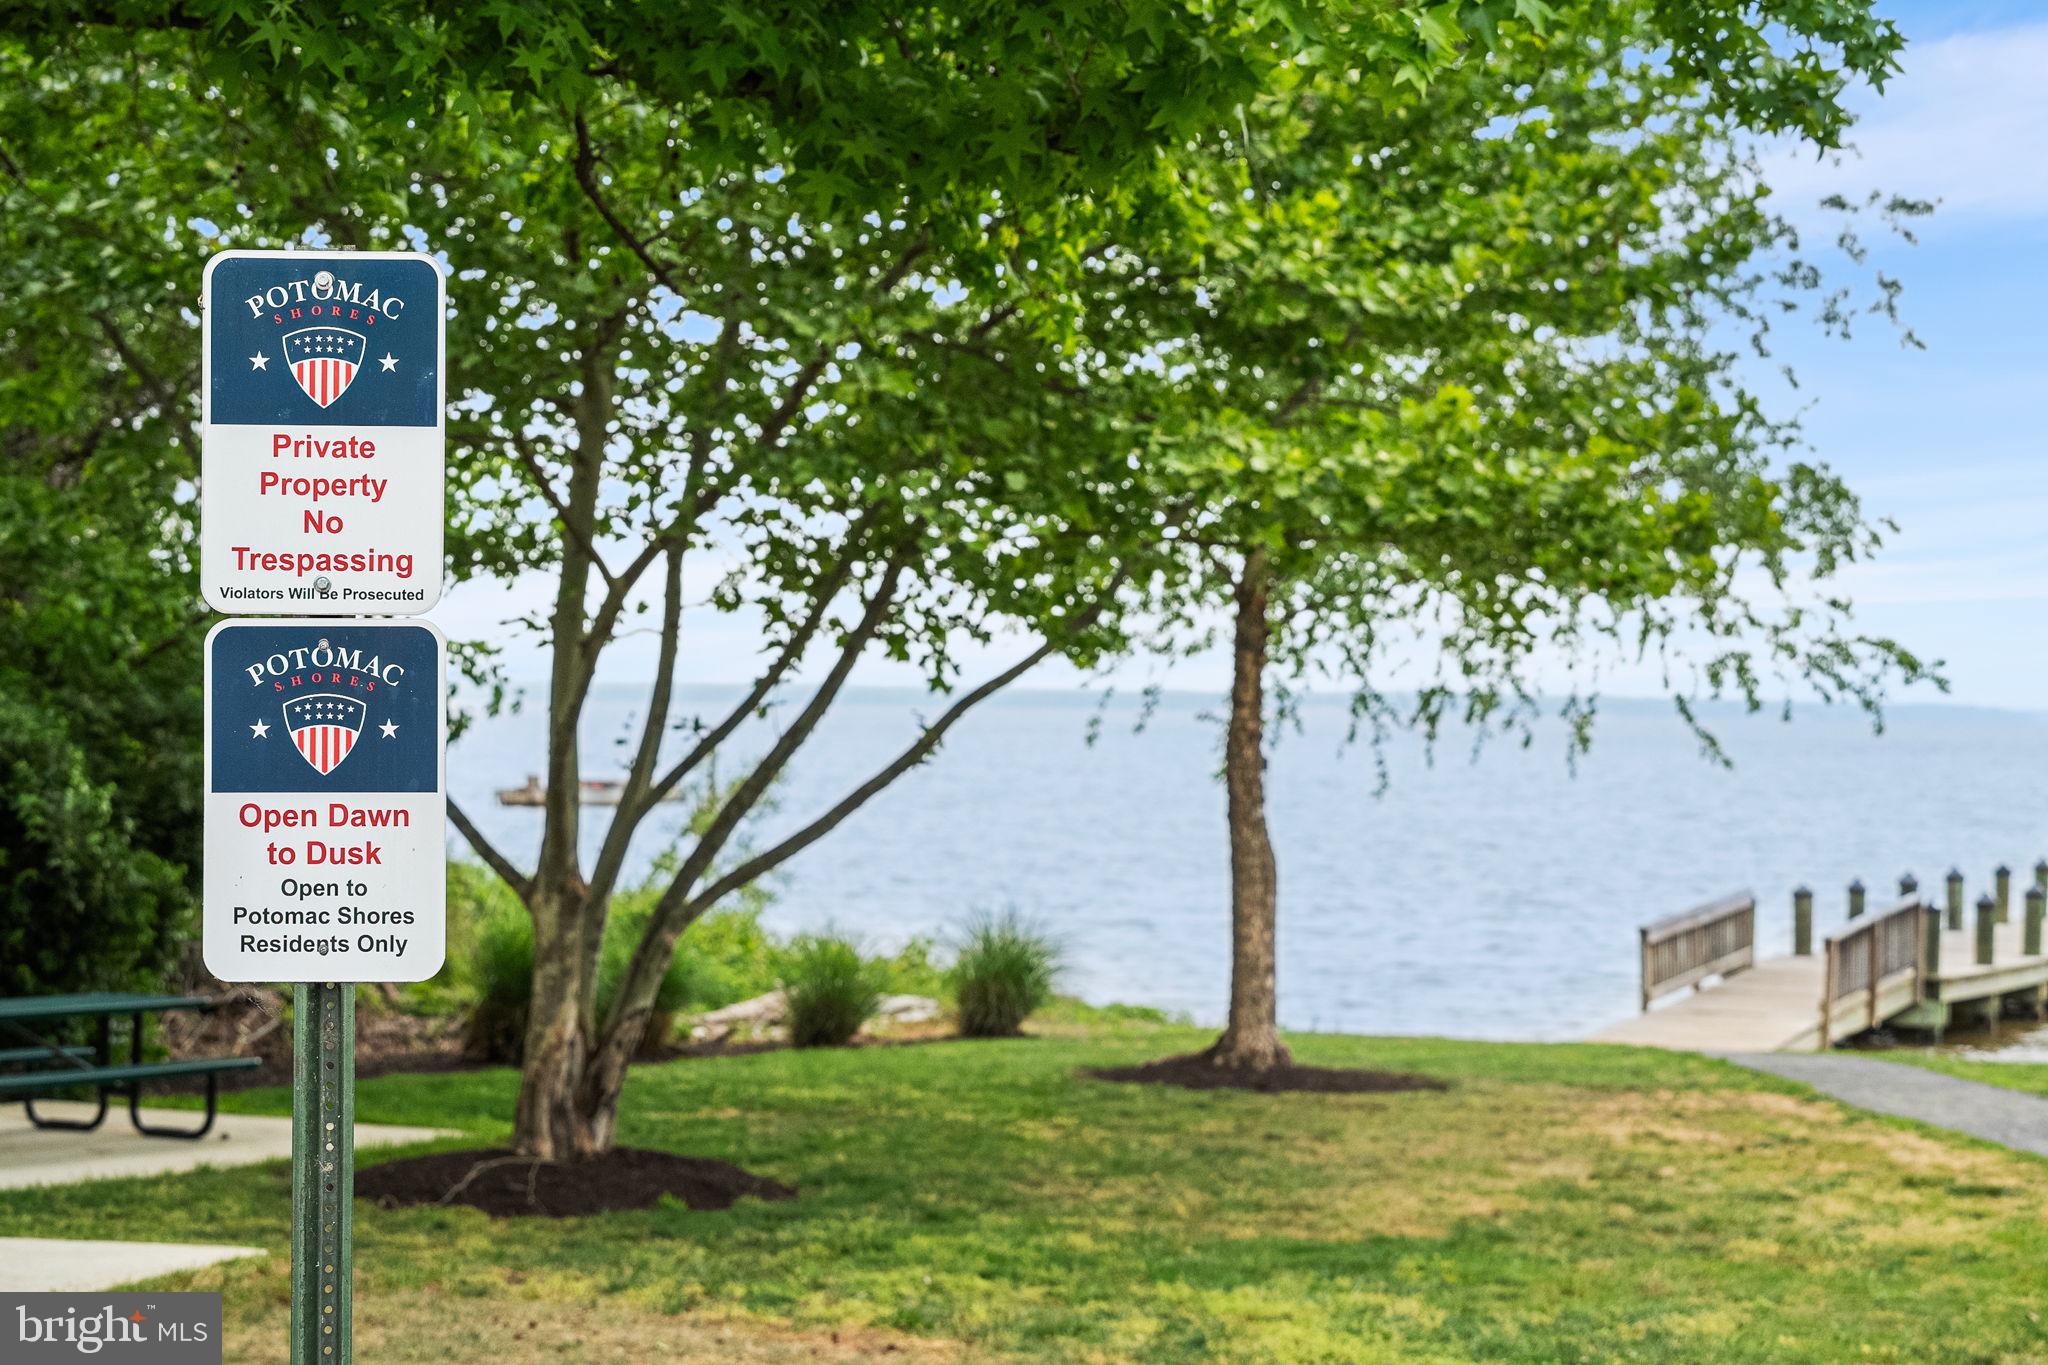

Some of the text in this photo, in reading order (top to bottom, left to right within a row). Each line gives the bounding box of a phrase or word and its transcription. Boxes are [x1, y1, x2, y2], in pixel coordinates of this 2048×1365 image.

[245, 279, 404, 321] POTOMAC
[274, 305, 376, 326] SHORES
[273, 434, 376, 459] Private
[260, 472, 387, 502] Property
[304, 510, 344, 535] No
[232, 547, 413, 578] Trespassing
[220, 587, 424, 601] Violators Will Be Prosecuted
[245, 646, 404, 687] POTOMAC
[275, 673, 376, 693] SHORES
[239, 803, 410, 833] Open Dawn
[267, 841, 381, 865] to Dusk
[281, 878, 368, 901] Open to
[233, 907, 414, 925] Potomac Shores
[240, 935, 408, 957] Residents Only
